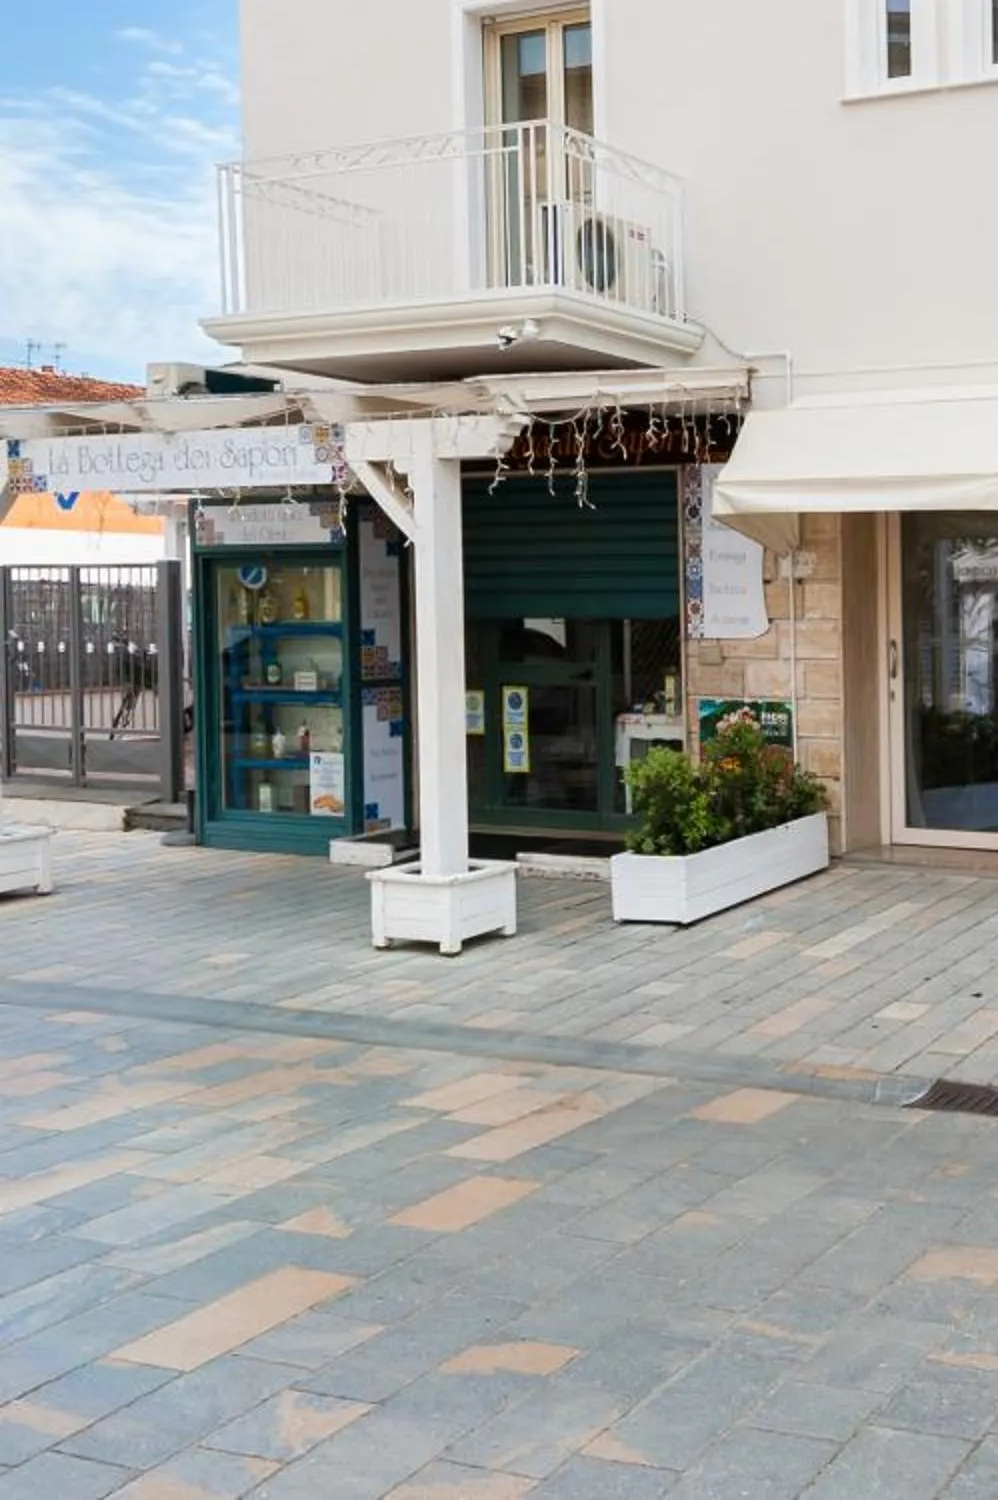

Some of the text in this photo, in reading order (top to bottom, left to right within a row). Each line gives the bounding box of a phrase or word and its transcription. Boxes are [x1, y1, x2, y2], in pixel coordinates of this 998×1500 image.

[78, 444, 164, 482] Bottega
[173, 443, 211, 470] dei
[219, 439, 297, 478] Sapori
